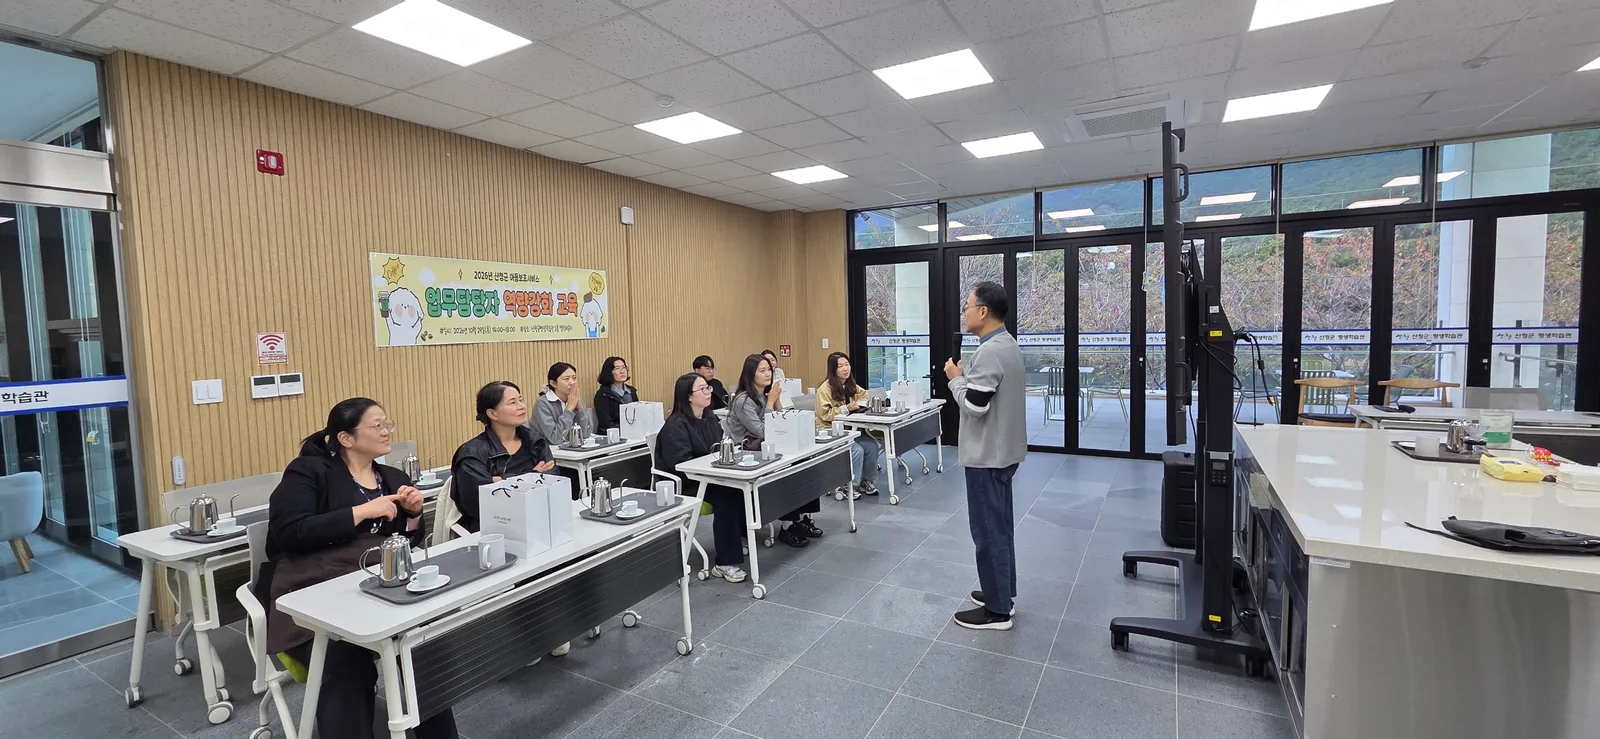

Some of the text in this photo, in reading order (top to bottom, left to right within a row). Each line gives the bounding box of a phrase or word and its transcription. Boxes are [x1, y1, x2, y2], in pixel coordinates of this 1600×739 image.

[474, 271, 493, 281] 2026년
[494, 272, 508, 281] 산청군
[425, 287, 578, 317] 업무담당자 역량강화 교육
